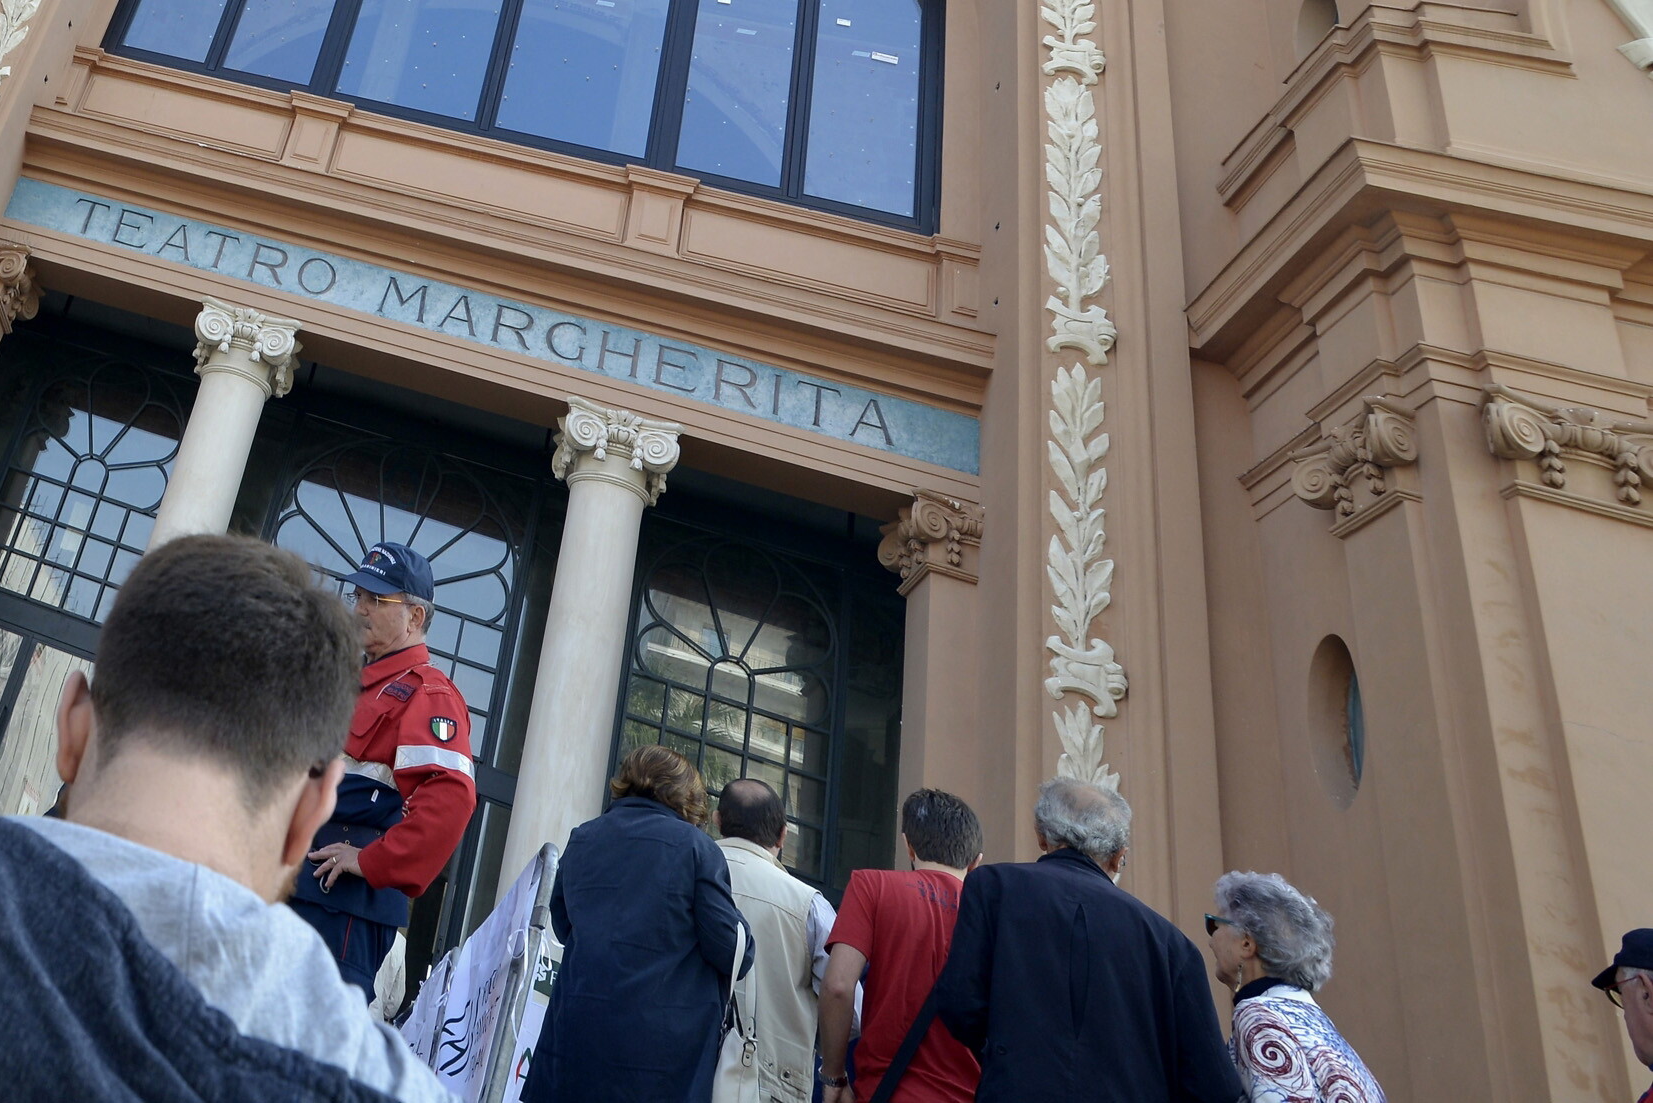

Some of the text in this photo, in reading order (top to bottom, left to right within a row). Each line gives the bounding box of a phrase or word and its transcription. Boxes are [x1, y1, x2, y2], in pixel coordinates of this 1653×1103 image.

[75, 198, 896, 447] TEATRO MARGHERITA
[433, 717, 454, 726] ITALIA
